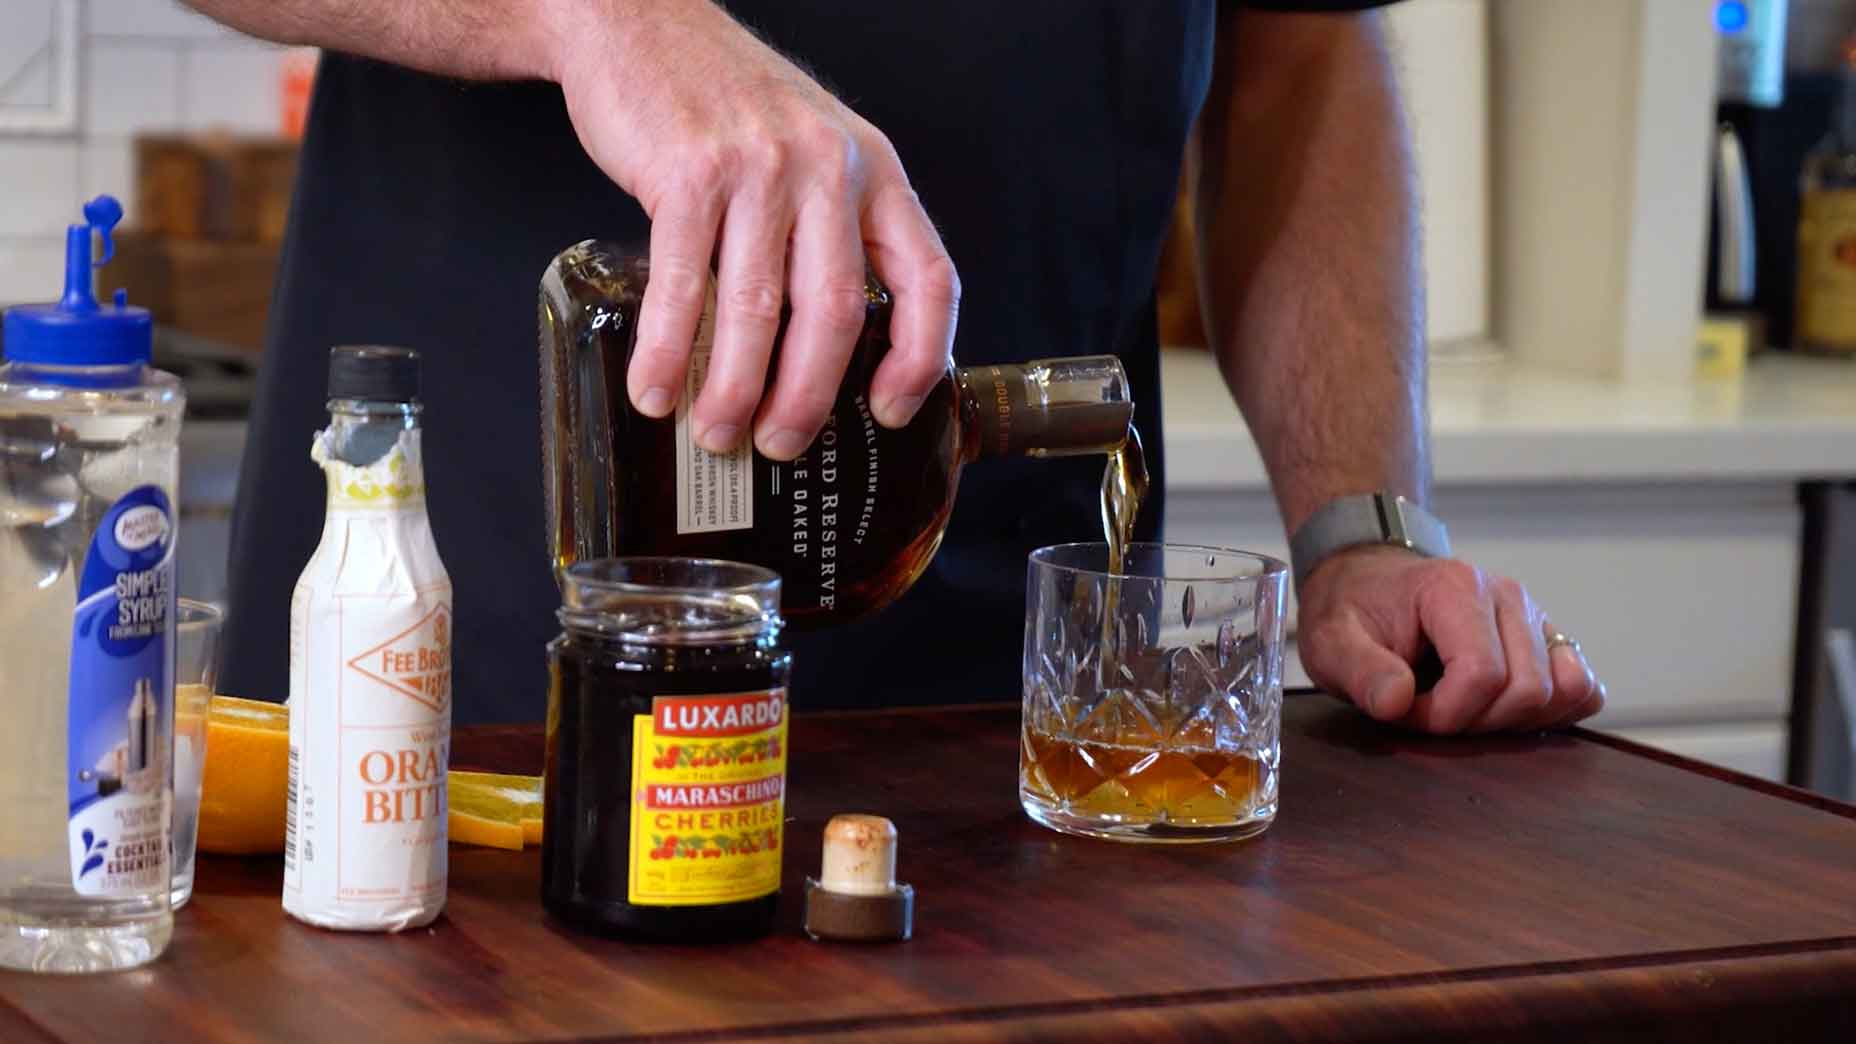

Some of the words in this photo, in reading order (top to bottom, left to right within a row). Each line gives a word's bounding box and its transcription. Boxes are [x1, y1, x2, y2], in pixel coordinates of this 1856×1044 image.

[793, 489, 808, 554] OAKED
[819, 493, 839, 609] RESERVE
[115, 568, 169, 599] SIMPLE
[118, 597, 168, 626] SYRUP
[662, 698, 782, 730] LUXARDO
[655, 776, 780, 806] MARASCHINO
[655, 804, 777, 830] CHERRIES
